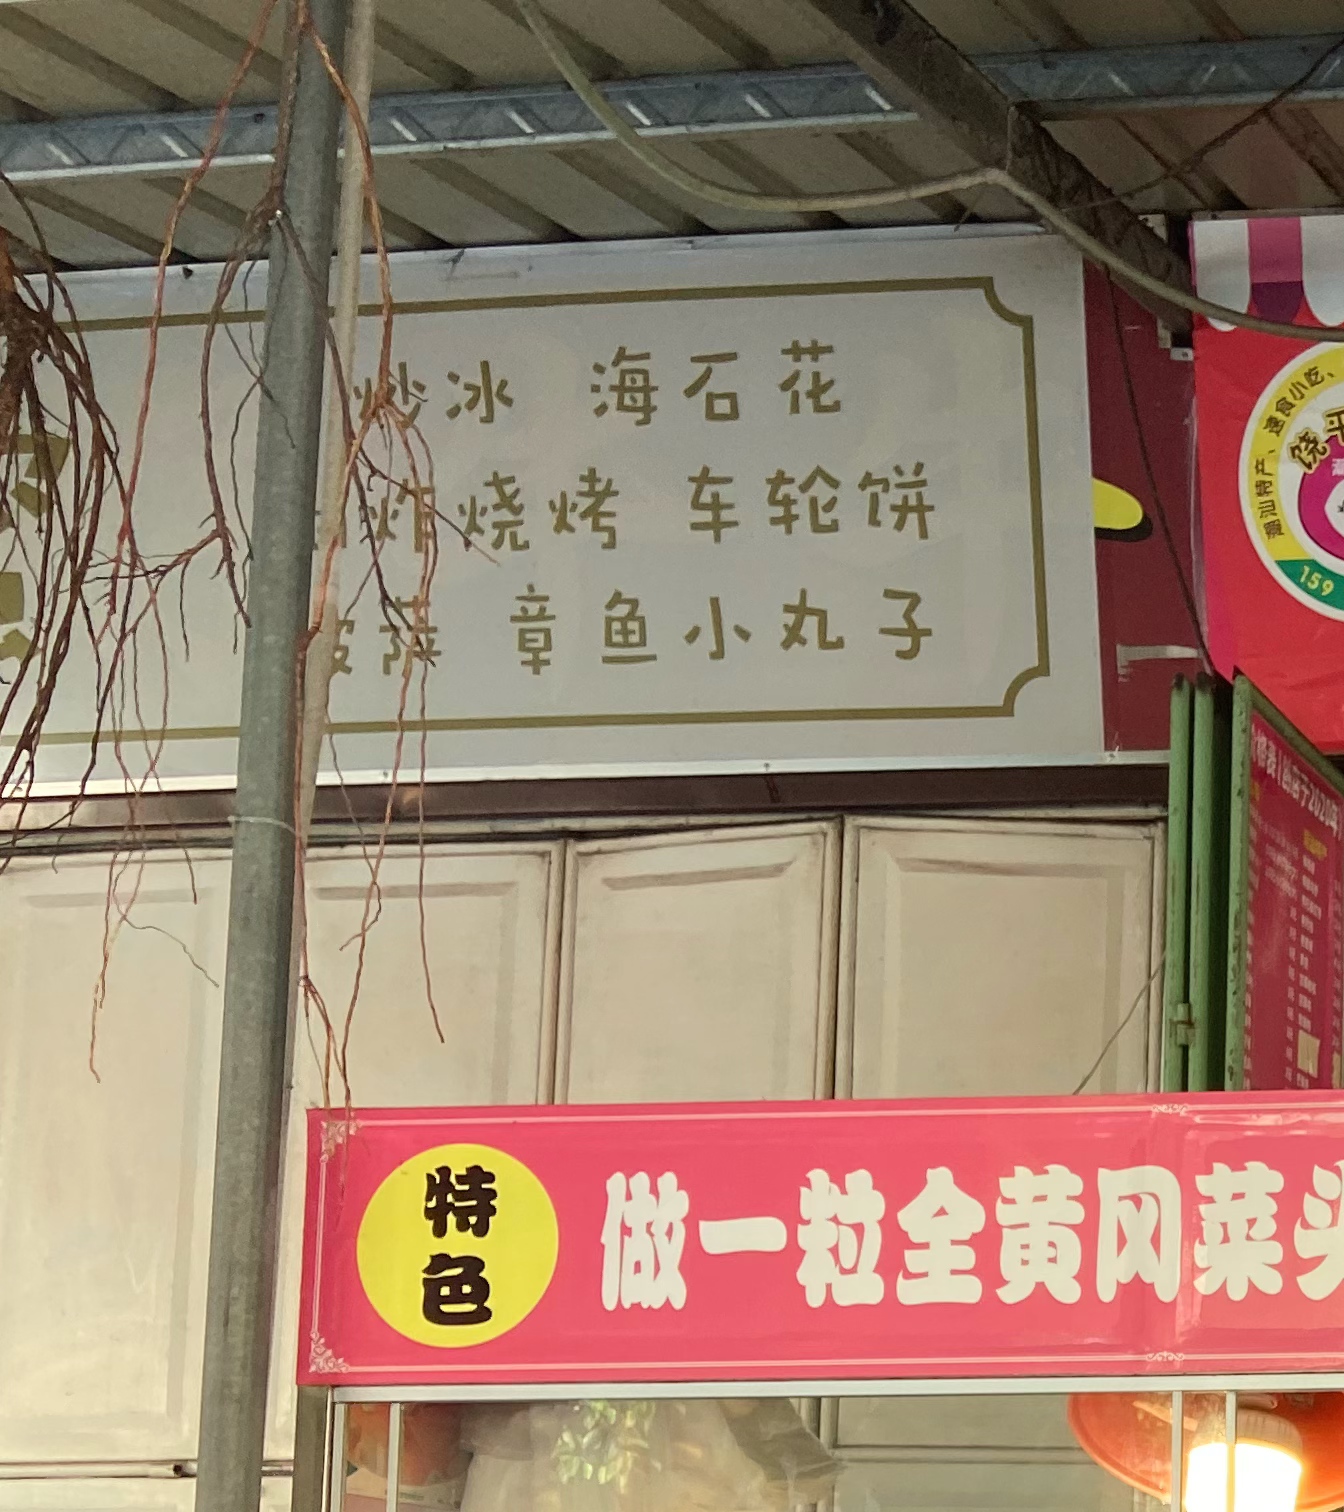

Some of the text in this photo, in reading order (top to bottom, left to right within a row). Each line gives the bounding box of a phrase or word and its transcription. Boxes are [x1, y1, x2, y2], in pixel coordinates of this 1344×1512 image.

[590, 339, 842, 427] 海石花
[314, 462, 935, 553] 炸烧烤 车轮饼
[1299, 564, 1334, 596] 159
[509, 584, 932, 675] 章鱼小丸子
[423, 1164, 498, 1327] 特色
